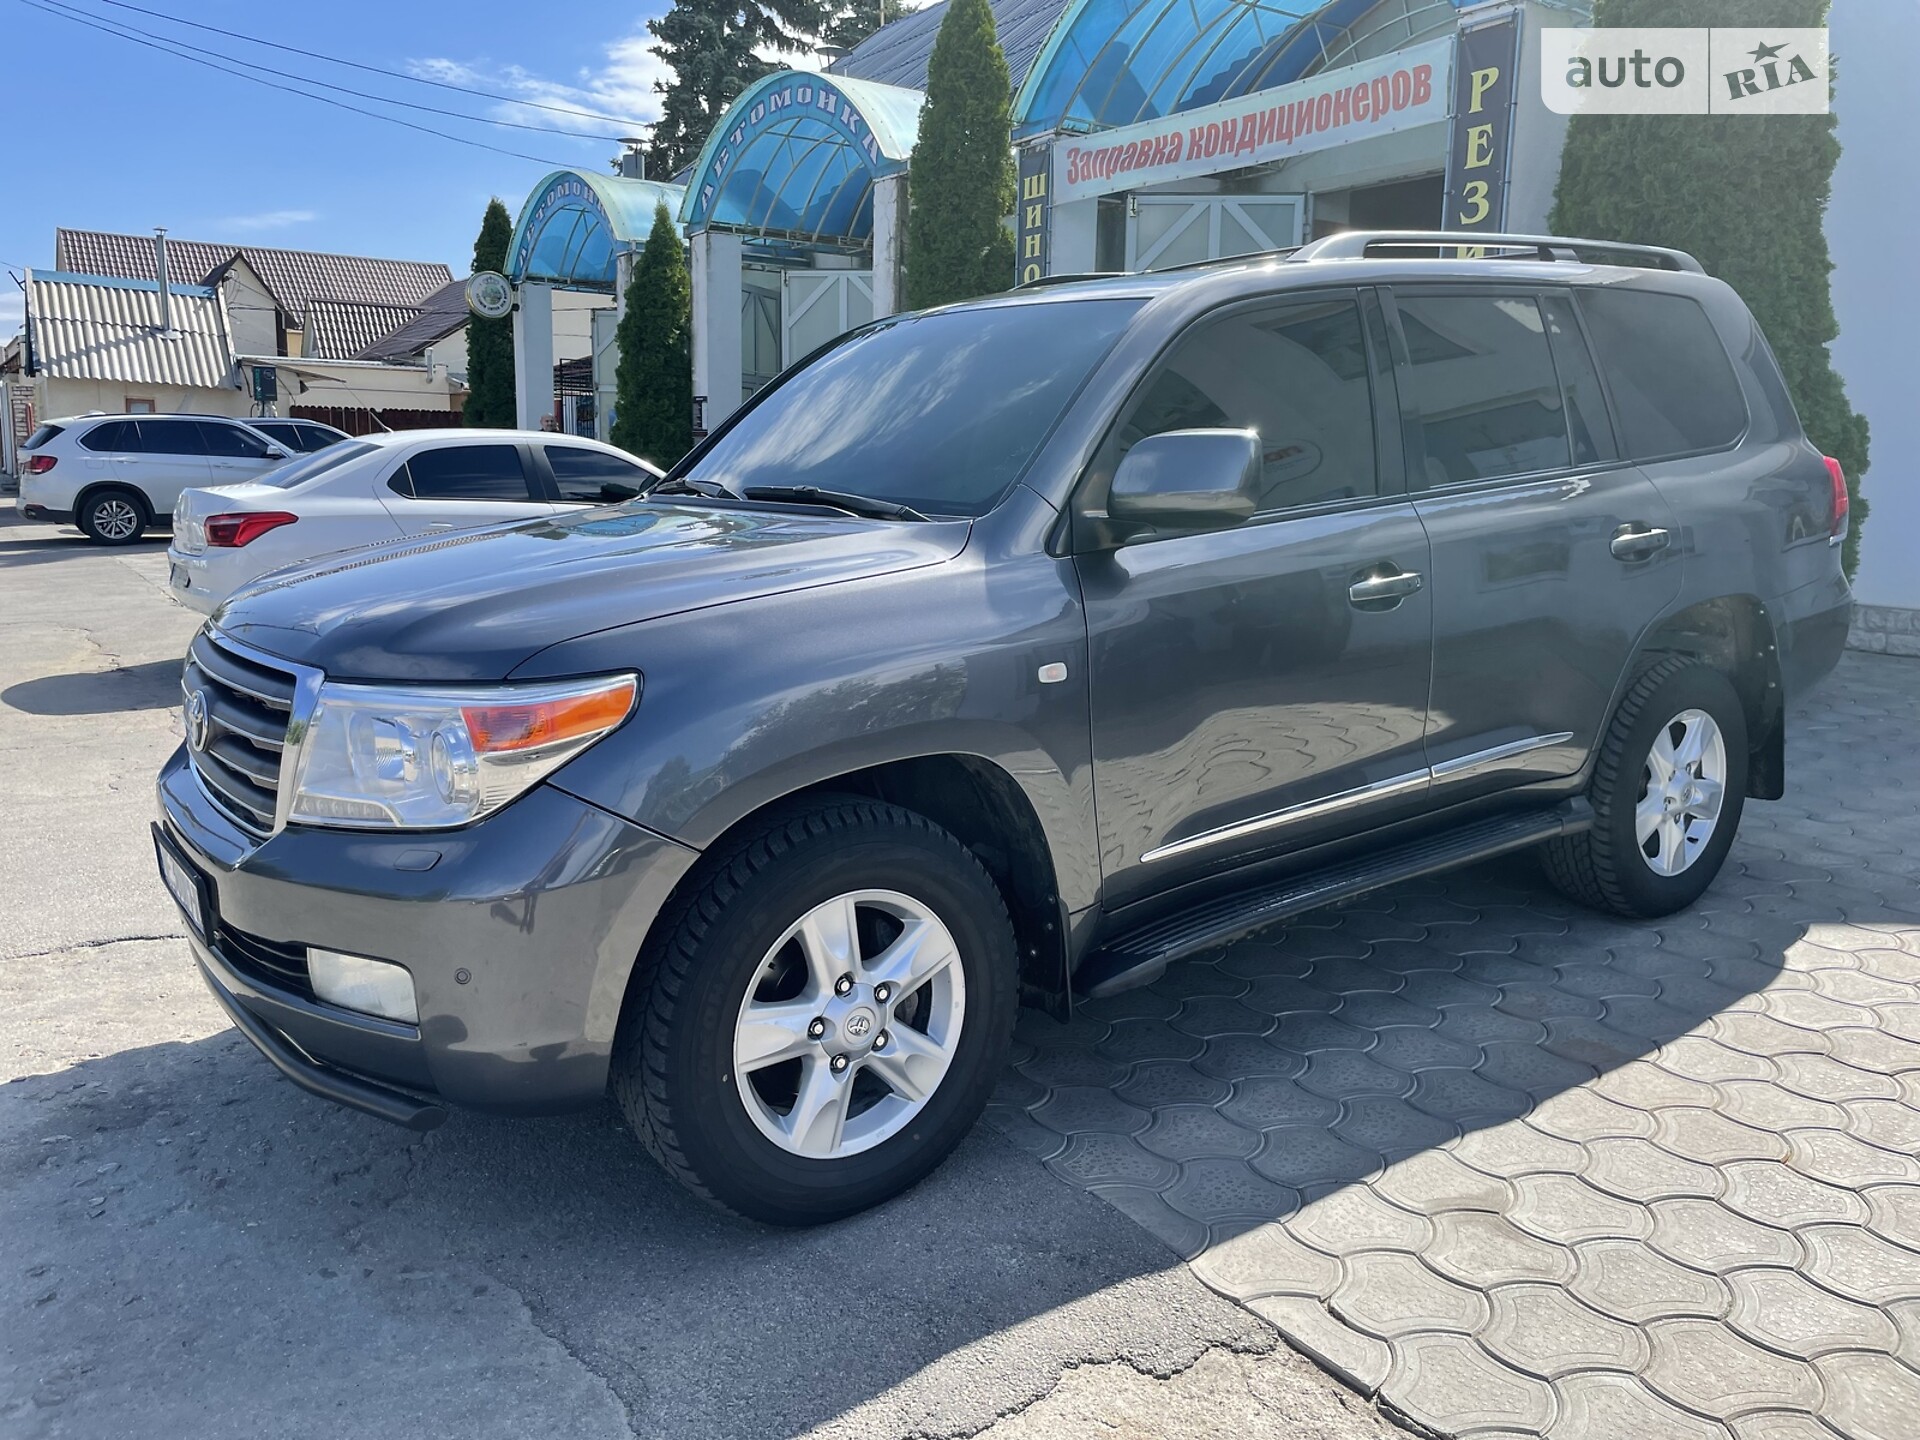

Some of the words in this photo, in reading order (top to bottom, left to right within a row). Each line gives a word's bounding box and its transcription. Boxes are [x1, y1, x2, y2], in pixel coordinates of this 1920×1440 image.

[701, 83, 880, 214] АВТОМОЙКА
[1066, 131, 1184, 185] Заправка
[1186, 64, 1432, 161] кондиционеров
[1023, 173, 1047, 283] ШИНО
